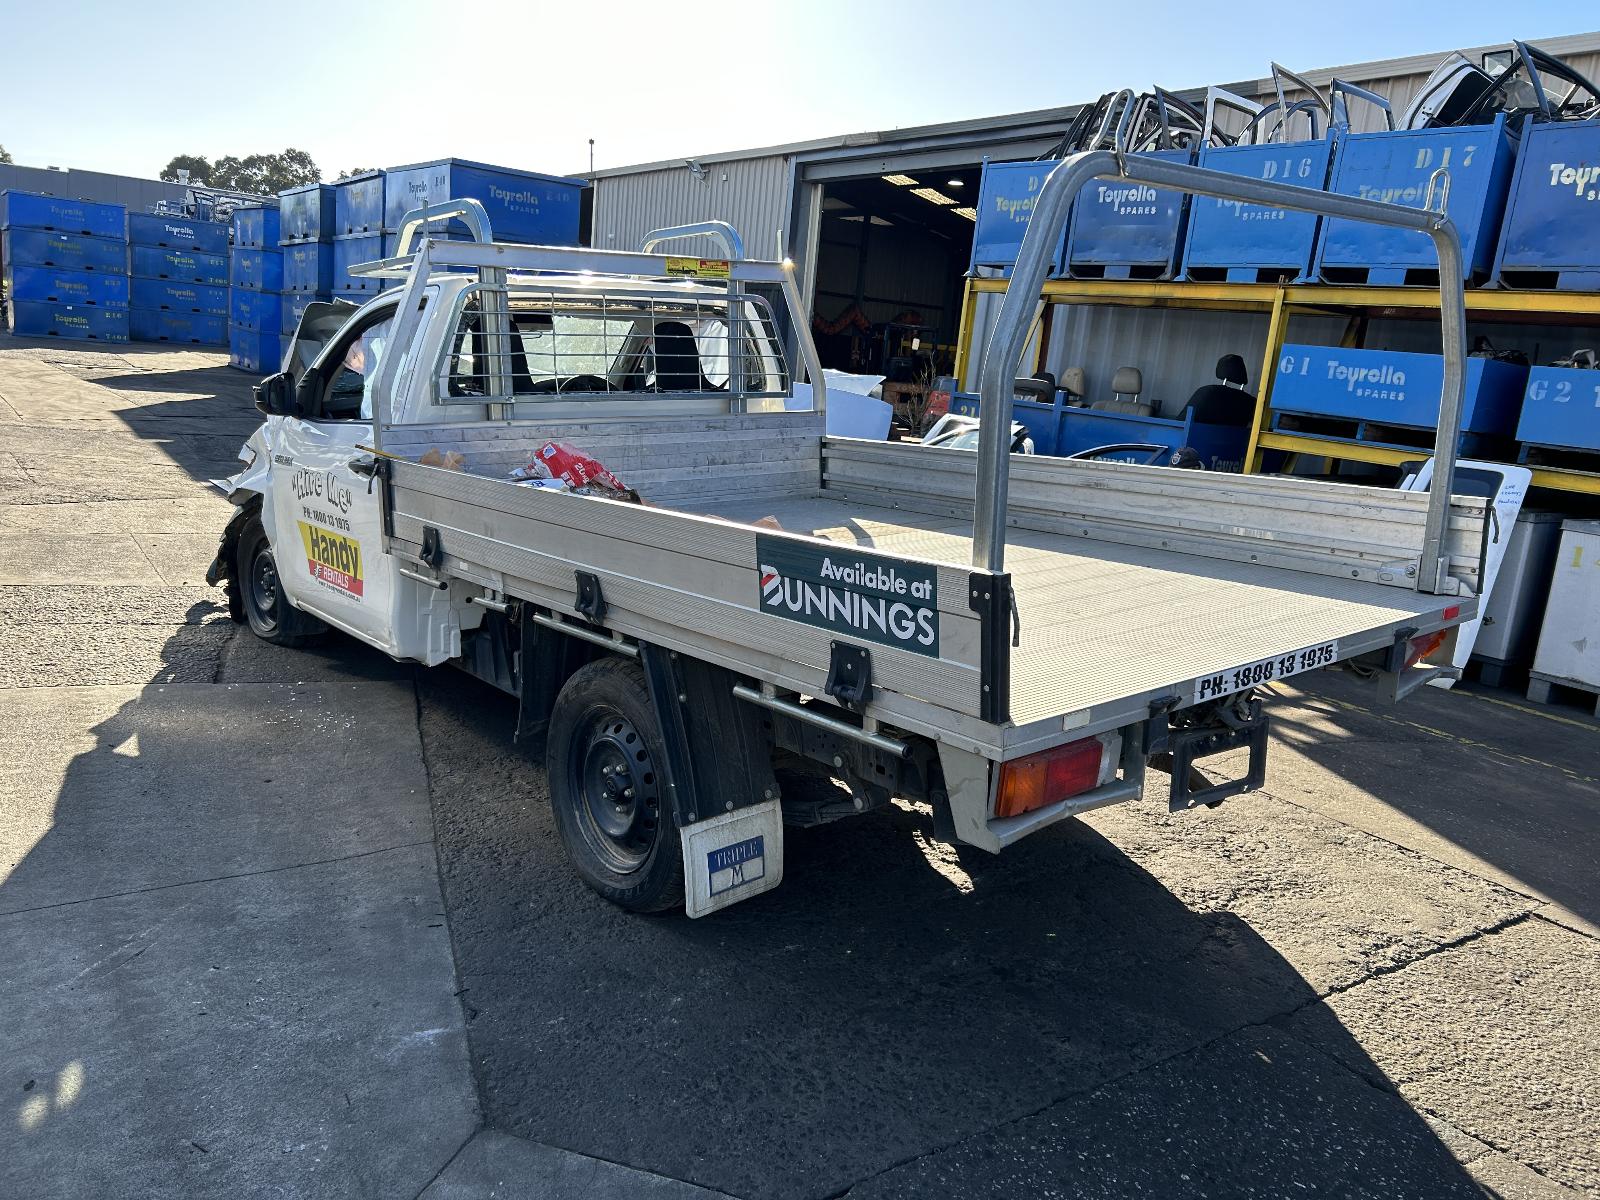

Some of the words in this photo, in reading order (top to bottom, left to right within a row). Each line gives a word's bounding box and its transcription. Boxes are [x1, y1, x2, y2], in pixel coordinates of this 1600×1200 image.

[1262, 158, 1312, 178] D16
[489, 184, 539, 206] Toyrolla
[1098, 185, 1157, 211] Toyrolla
[510, 204, 540, 214] SPARES
[1120, 206, 1157, 215] SPARES
[1243, 210, 1285, 221] SPARES
[165, 224, 194, 238] Toyrolla
[1327, 360, 1406, 391] Toyrolla
[1356, 388, 1406, 401] SPARES
[308, 525, 359, 583] Handy
[323, 563, 349, 590] RENTALS
[820, 557, 907, 595] Available
[910, 579, 933, 600] at
[760, 564, 935, 646] BUNNINGS
[1199, 675, 1228, 699] PH:
[1232, 660, 1274, 689] 1800
[1278, 652, 1297, 676] 13
[1300, 644, 1334, 670] 1975
[714, 841, 758, 868] TRIPLE
[730, 862, 746, 889] M
